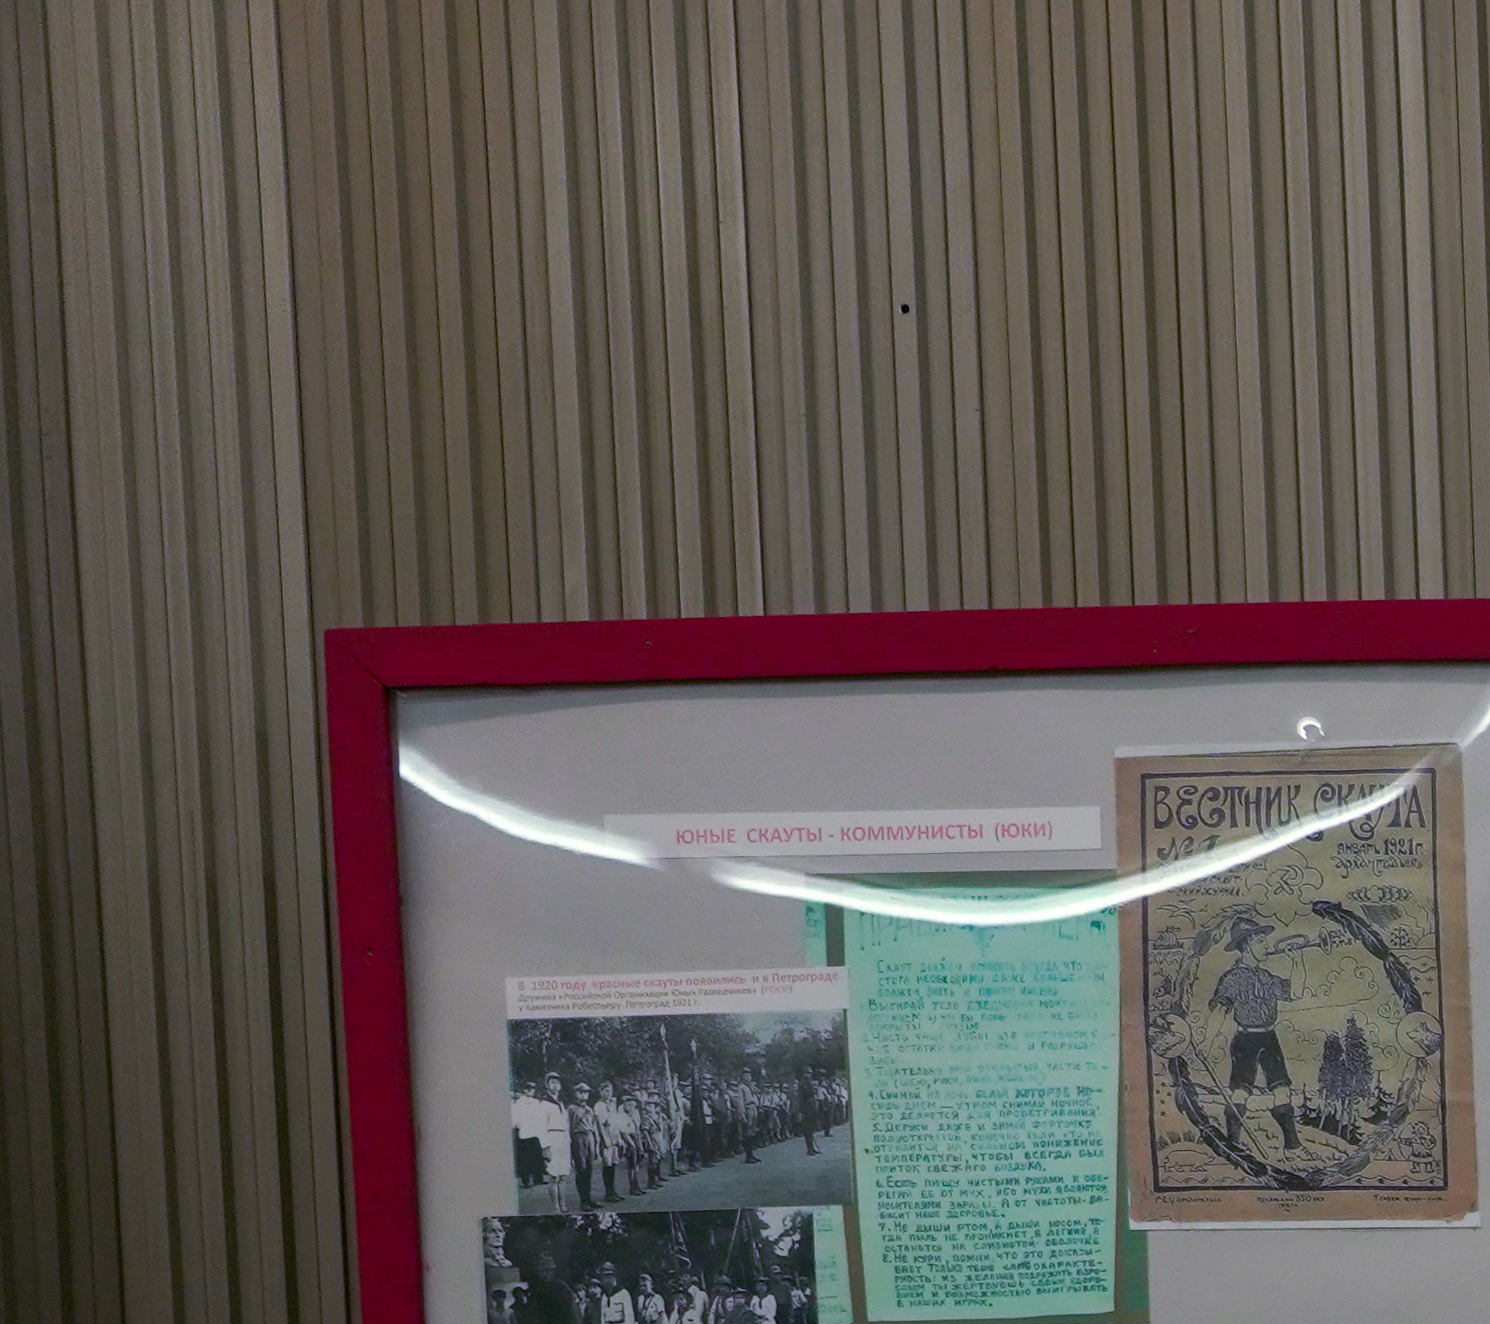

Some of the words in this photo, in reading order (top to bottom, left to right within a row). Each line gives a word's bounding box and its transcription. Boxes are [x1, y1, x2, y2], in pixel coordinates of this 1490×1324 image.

[676, 828, 736, 844] ЮНЫЕ
[746, 826, 822, 843] СКАУТЫ
[840, 823, 983, 841] КОММУНИСТЫ
[994, 821, 1053, 841] (ЮКИ)
[518, 980, 525, 991] В
[531, 979, 558, 991] 1920
[561, 980, 586, 992] году
[592, 979, 641, 991] красные
[644, 977, 683, 989] скауты
[685, 975, 746, 987] появились
[753, 974, 759, 983] и
